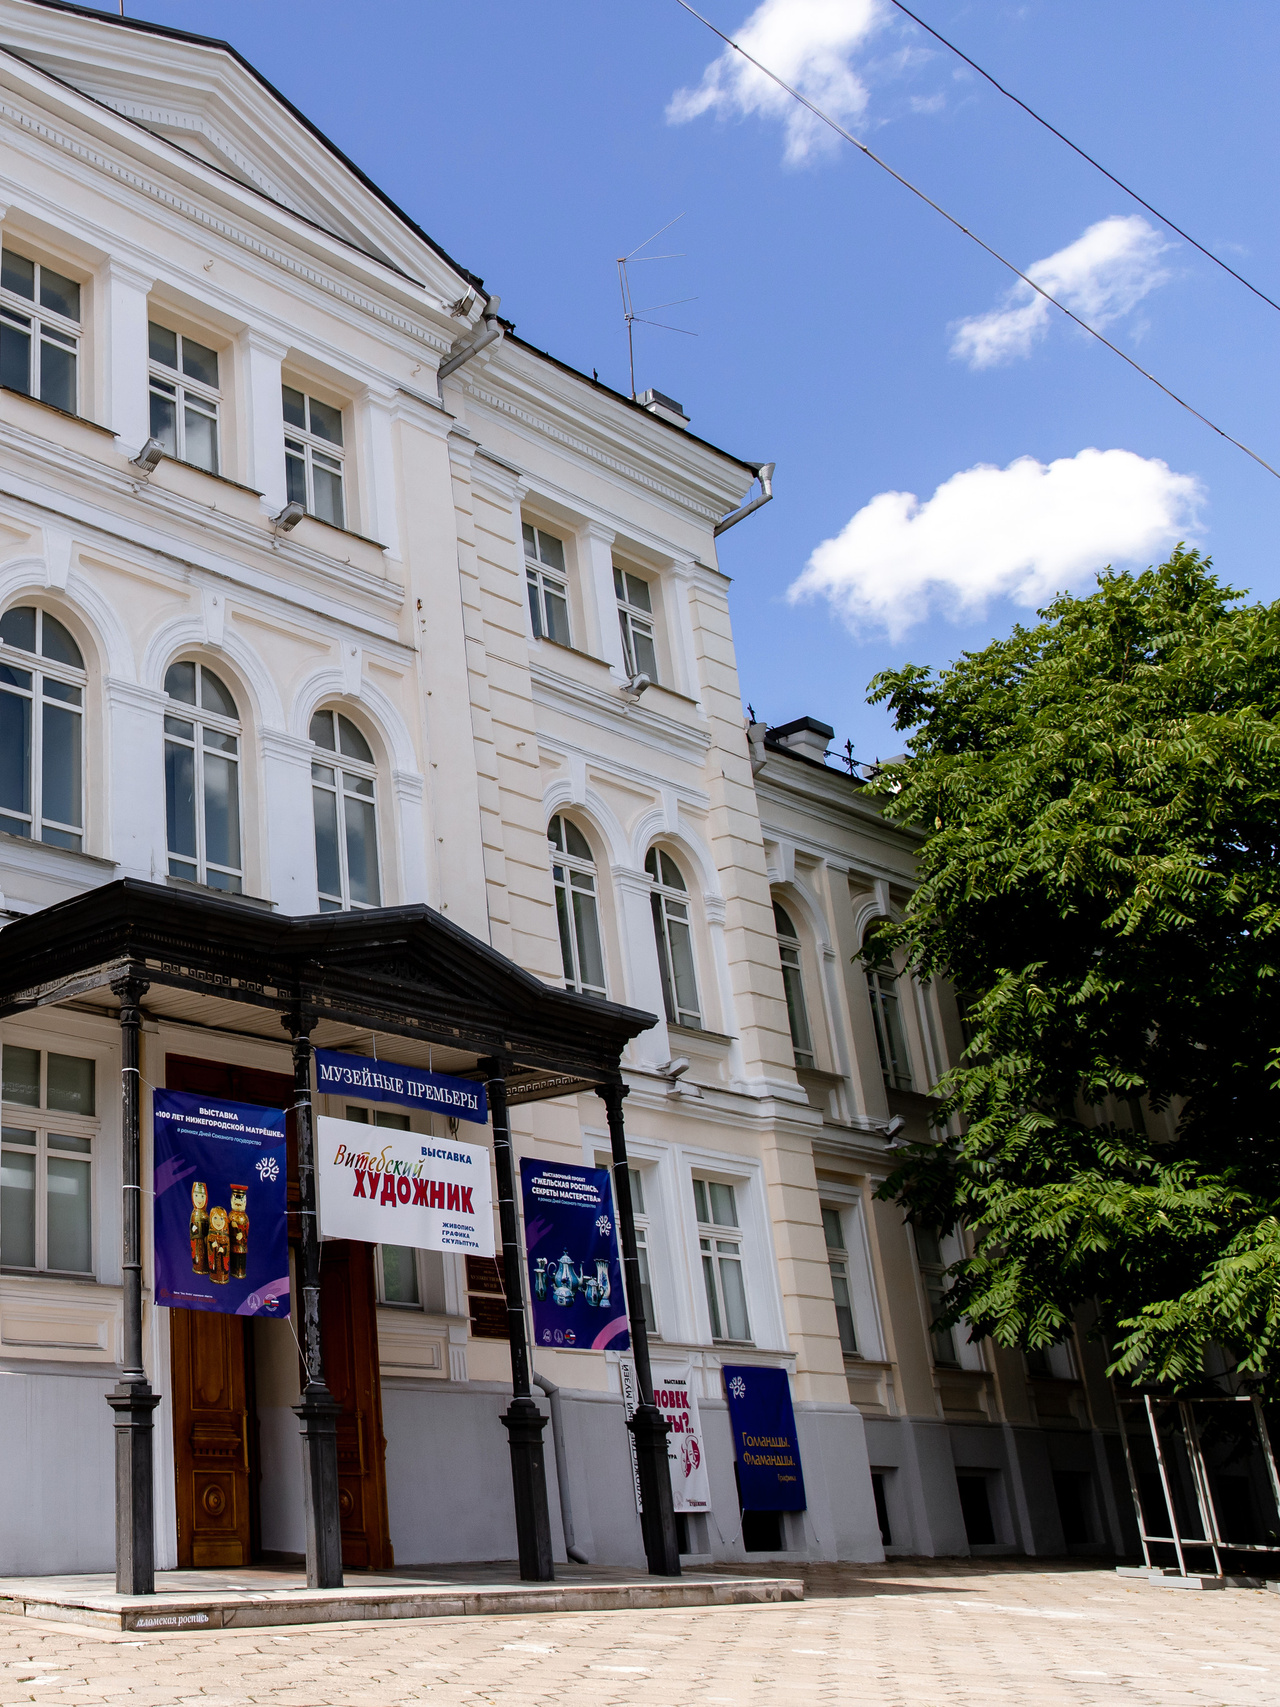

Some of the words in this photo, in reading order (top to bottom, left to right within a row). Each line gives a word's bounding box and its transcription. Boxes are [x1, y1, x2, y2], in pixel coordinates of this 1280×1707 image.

[320, 1064, 404, 1094] МУЗЕЙНЫЕ
[407, 1080, 478, 1110] ПРЕМЬЕРЫ
[199, 1107, 238, 1120] ВЫСТАВКА
[155, 1110, 171, 1119] «100
[171, 1113, 184, 1122] ЛЕТ
[185, 1115, 244, 1132] НИЖЕГОРОДСКОЙ
[245, 1126, 284, 1138] МАТРЁШКЕ»
[198, 1130, 211, 1138] Дней
[211, 1133, 233, 1141] Союзного
[333, 1144, 425, 1178] Витебский
[421, 1146, 472, 1165] ВЫСТАВКА
[531, 1177, 569, 1189] «ГЖЕЛЬСКАЯ
[353, 1168, 475, 1214] ХУДОЖНИК
[531, 1186, 559, 1197] СЕКРЕТЫ
[559, 1190, 601, 1202] МАСТЕРСТВА»
[442, 1222, 475, 1232] ЖИВОПИСЬ
[441, 1230, 470, 1239] ГРАФИКА
[441, 1237, 479, 1248] СКУЛЬПТУРА
[622, 1364, 632, 1399] МУЗЕЙ
[177, 1614, 209, 1626] роспись
